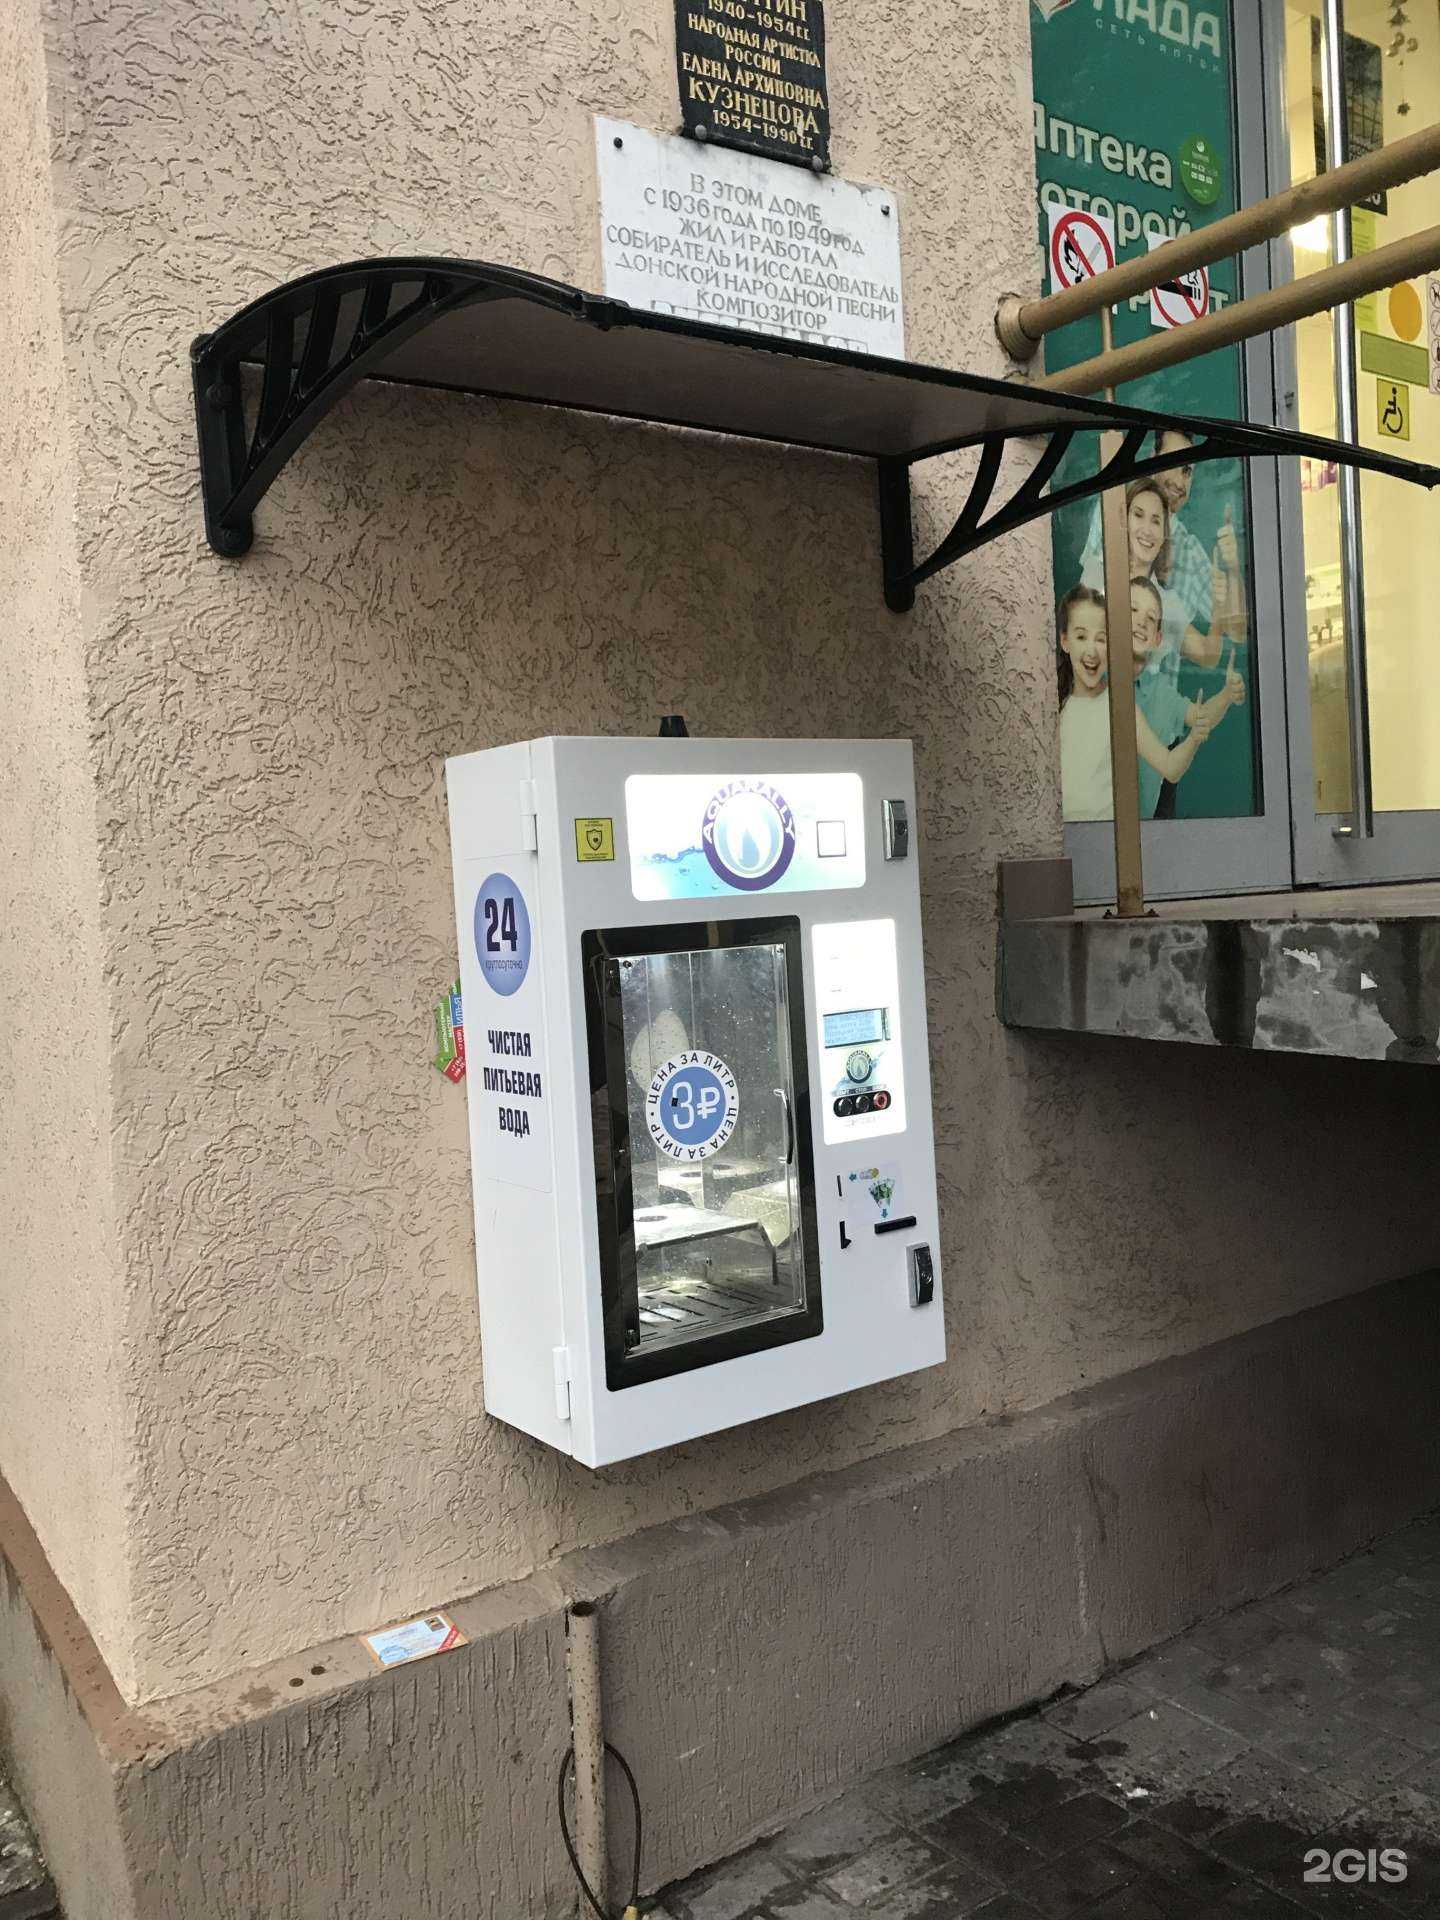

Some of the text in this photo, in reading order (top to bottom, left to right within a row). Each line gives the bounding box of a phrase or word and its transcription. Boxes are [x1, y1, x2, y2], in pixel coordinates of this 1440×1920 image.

[687, 13, 821, 68] НАРОДНАЯ АРТИСТКА
[1095, 18, 1146, 46] СЕТЬ
[681, 51, 826, 110] ЕЛЕНА АРХИПОВНА
[724, 43, 782, 75] РОССИИ
[688, 76, 820, 134] КУЗНЕЦОВА
[643, 187, 657, 205] С
[662, 189, 710, 219] 1936
[713, 205, 758, 231] ГОДА
[762, 217, 784, 237] ПО
[788, 220, 832, 247] 1949
[690, 172, 705, 194] В
[711, 180, 764, 210] ЭТОМ
[1036, 182, 1192, 248] оторой
[606, 224, 899, 303] СОБИРАТЕЛЬ И ИССЛЕДОВАТЕЛЬ
[678, 217, 838, 269] ЖИЛ И РАБОТАЛ
[615, 251, 896, 323] ДОНСКОЙ НАРОДНОЙ ПЕСНИ
[697, 288, 828, 330] КОМПОЗИТОР
[484, 896, 518, 952] 24
[487, 1029, 532, 1058] ЧИСТАЯ
[483, 1066, 542, 1098] ПИТЬЕВАЯ
[648, 1052, 735, 1104] ЦЕНА ЗА ЛИТР
[498, 1106, 531, 1139] ВОДА
[650, 1107, 737, 1159] ЦЕНА ЗА ЛИТР
